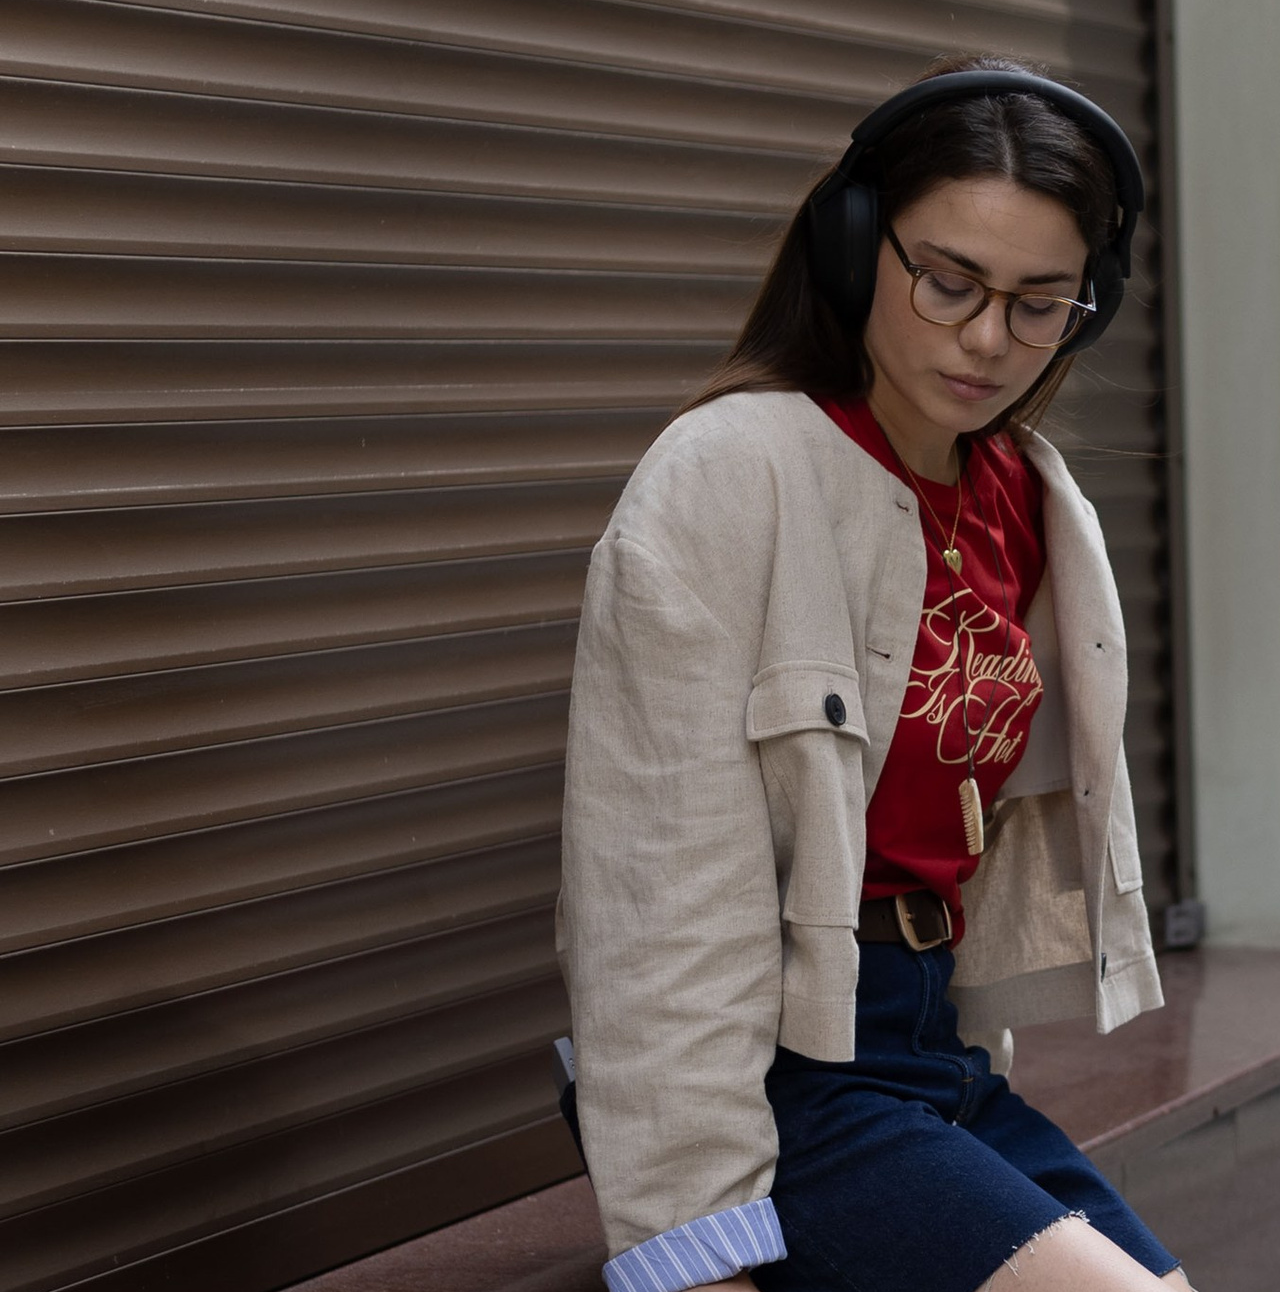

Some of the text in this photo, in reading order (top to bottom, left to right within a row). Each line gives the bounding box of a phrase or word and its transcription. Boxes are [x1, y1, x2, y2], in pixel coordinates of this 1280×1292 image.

[911, 588, 1044, 706] Reading
[899, 667, 961, 724] Is
[936, 676, 1022, 765] Hot
